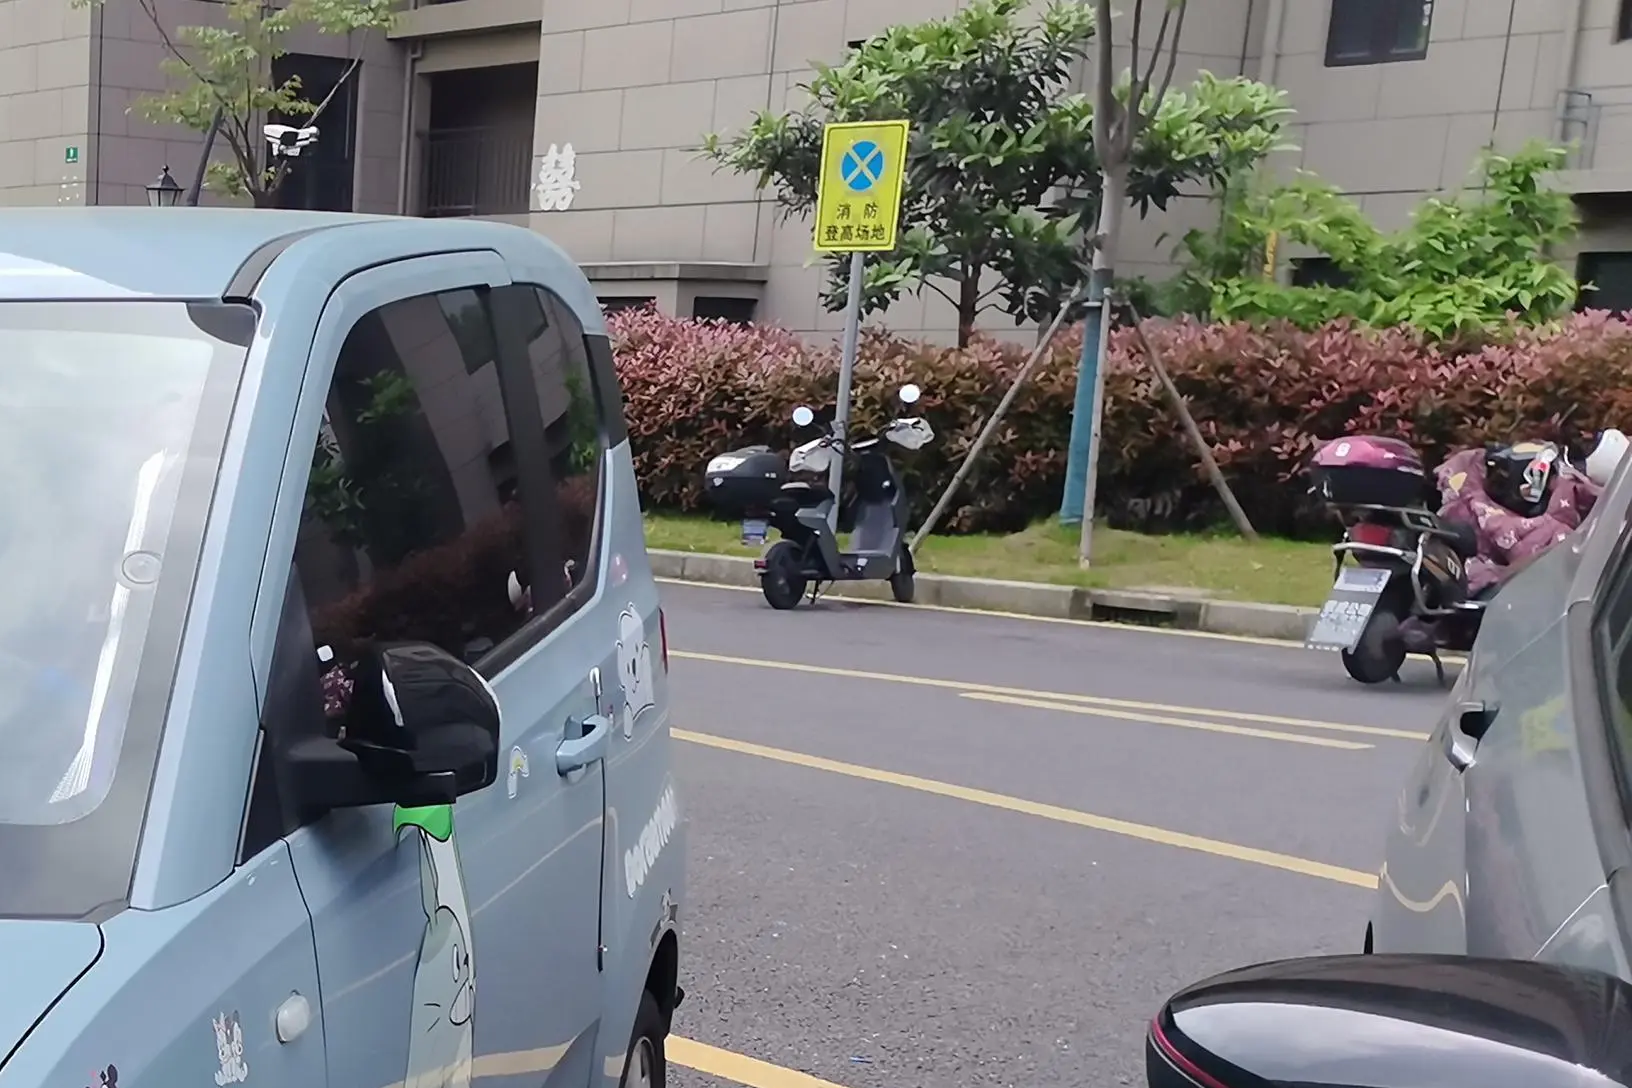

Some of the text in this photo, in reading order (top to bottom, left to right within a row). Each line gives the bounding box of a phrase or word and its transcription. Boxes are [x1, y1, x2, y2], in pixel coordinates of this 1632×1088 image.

[836, 202, 878, 220] 消防
[824, 223, 886, 242] 登高场地
